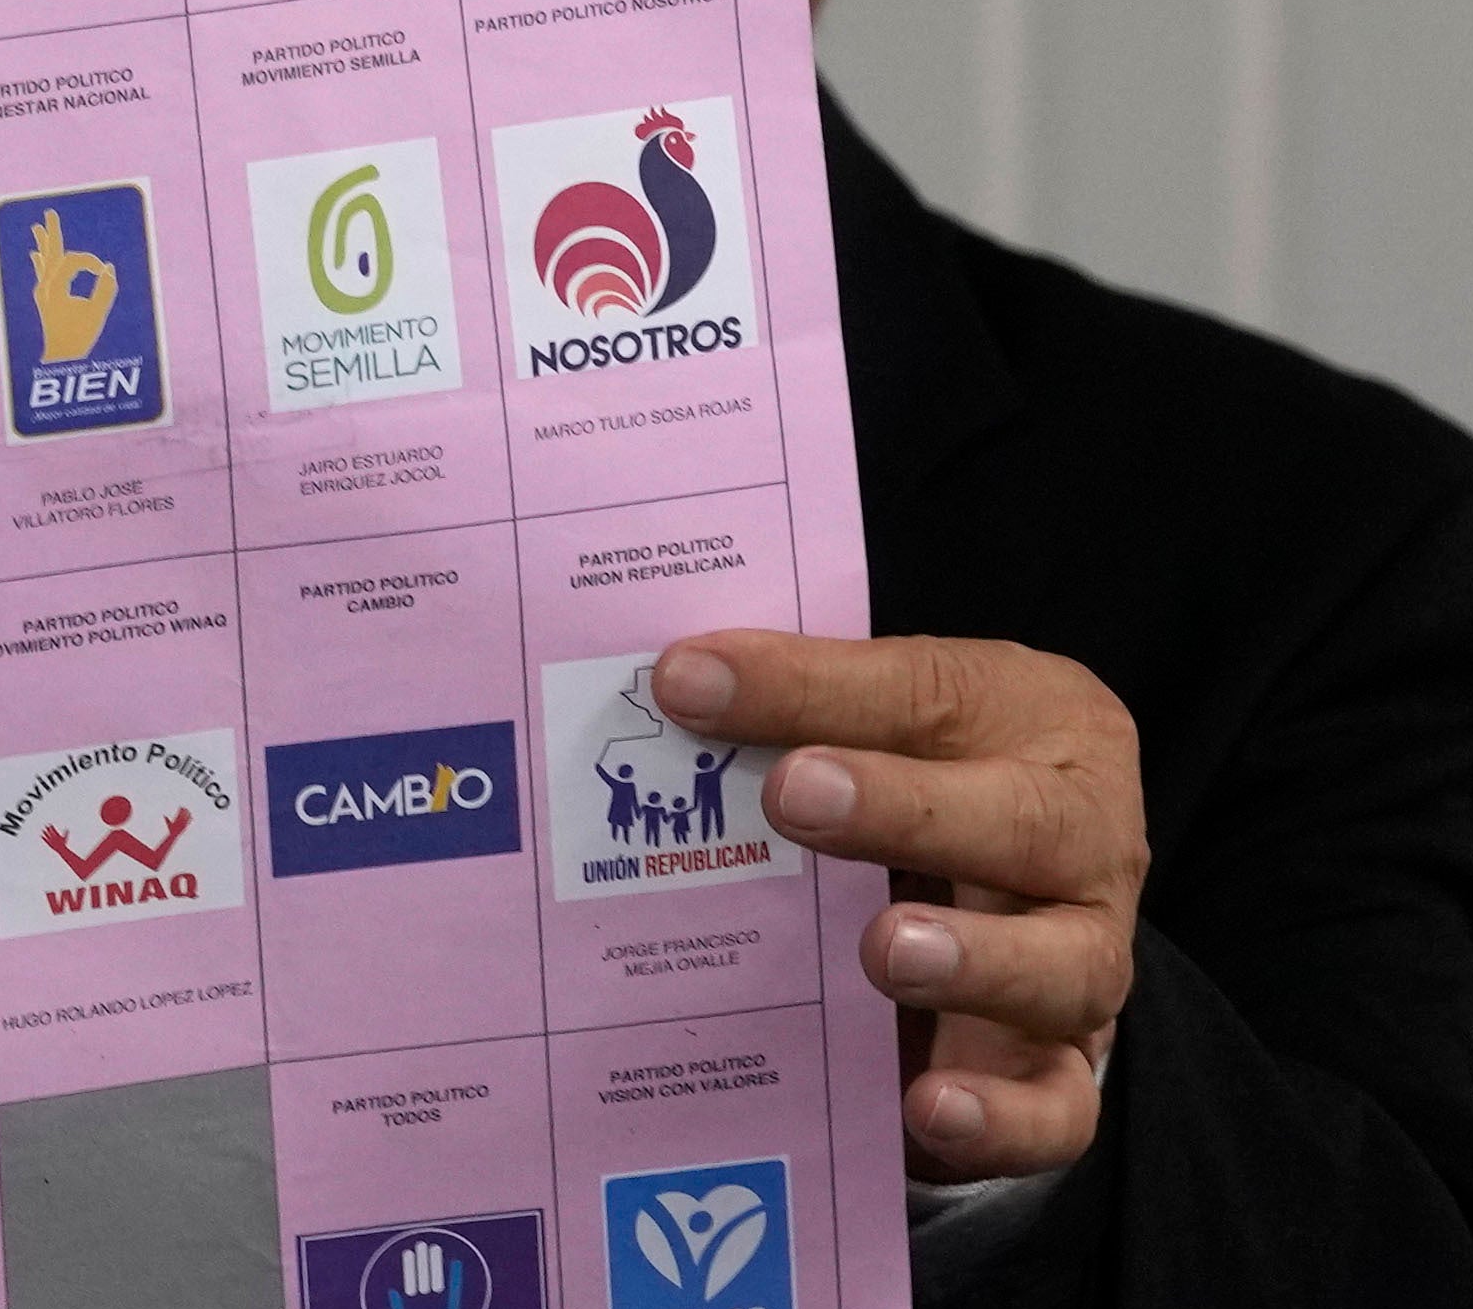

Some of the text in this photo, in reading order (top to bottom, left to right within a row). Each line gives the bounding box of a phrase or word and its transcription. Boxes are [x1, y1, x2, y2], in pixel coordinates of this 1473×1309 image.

[474, 10, 547, 33] PARTIDO
[252, 30, 406, 65] PARTIDO POLITICO
[55, 67, 134, 91] POLITICO
[241, 49, 421, 87] MOVIMIENTO SEMILLA
[63, 87, 150, 110] NACIONAL
[282, 315, 438, 357] MOVIMIENTO
[530, 317, 742, 378] NOSOTROS
[285, 345, 442, 392] SEMILLA
[29, 366, 141, 409] BIEN
[534, 396, 752, 441] MARCO TULIO SOSA ROJAS
[578, 534, 734, 569] PARTIDO POLITICO
[299, 569, 459, 600] PARTIDO POLITICO
[569, 553, 746, 590] UNION REPUBLICANA
[22, 600, 180, 635] PARTIDO POLITICO
[346, 593, 415, 614] CAMBIO
[87, 621, 166, 644] POLITICO
[169, 613, 227, 633] WINAQ
[145, 743, 231, 811] Político
[295, 763, 493, 826] CAMBIO
[583, 839, 772, 884] UNIÓN REPUBLICANA
[45, 872, 199, 916] WINAQ
[610, 1053, 767, 1083] PARTIDO POLITICO
[332, 1084, 490, 1114] PARTIDO POLITICO
[598, 1070, 780, 1105] VISION CON VALORES
[382, 1107, 442, 1127] TODOS
